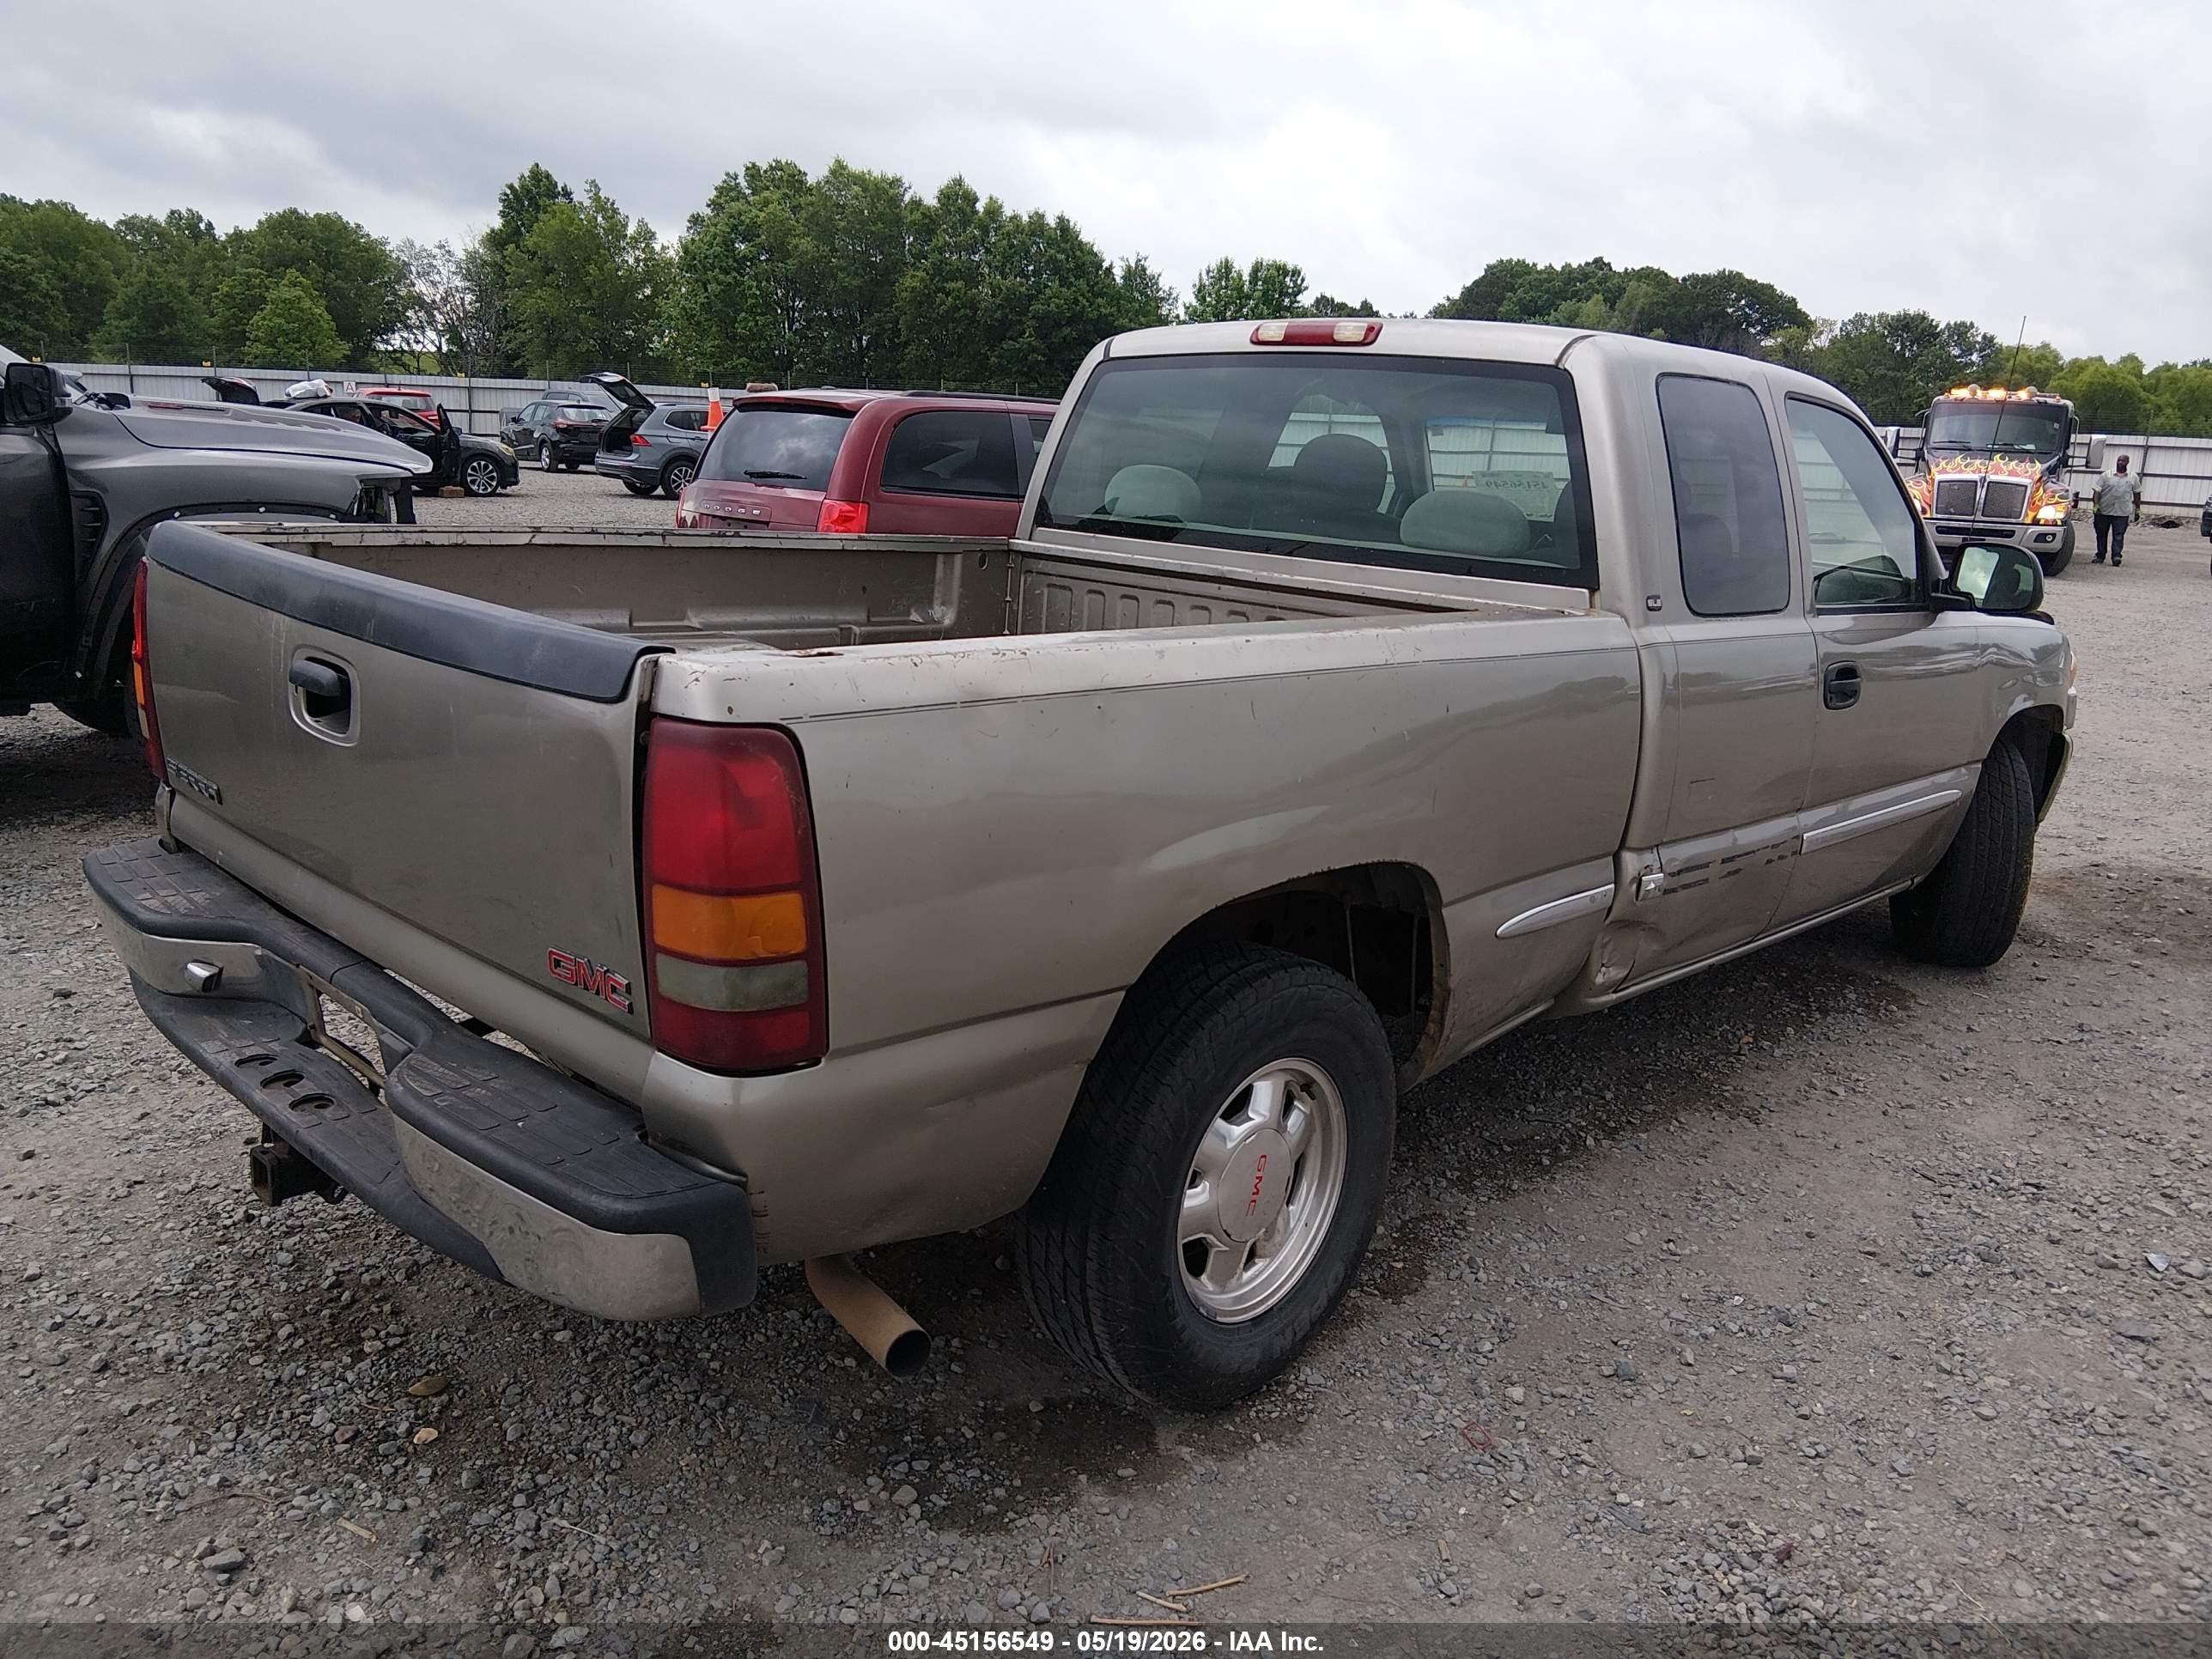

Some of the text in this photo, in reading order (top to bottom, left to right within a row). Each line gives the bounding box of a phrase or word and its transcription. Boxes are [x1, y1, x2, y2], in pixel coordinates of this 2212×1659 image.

[345, 382, 355, 392] A
[704, 503, 761, 515] DODGE
[548, 946, 635, 1015] GMC
[1245, 1154, 1267, 1217] GMC
